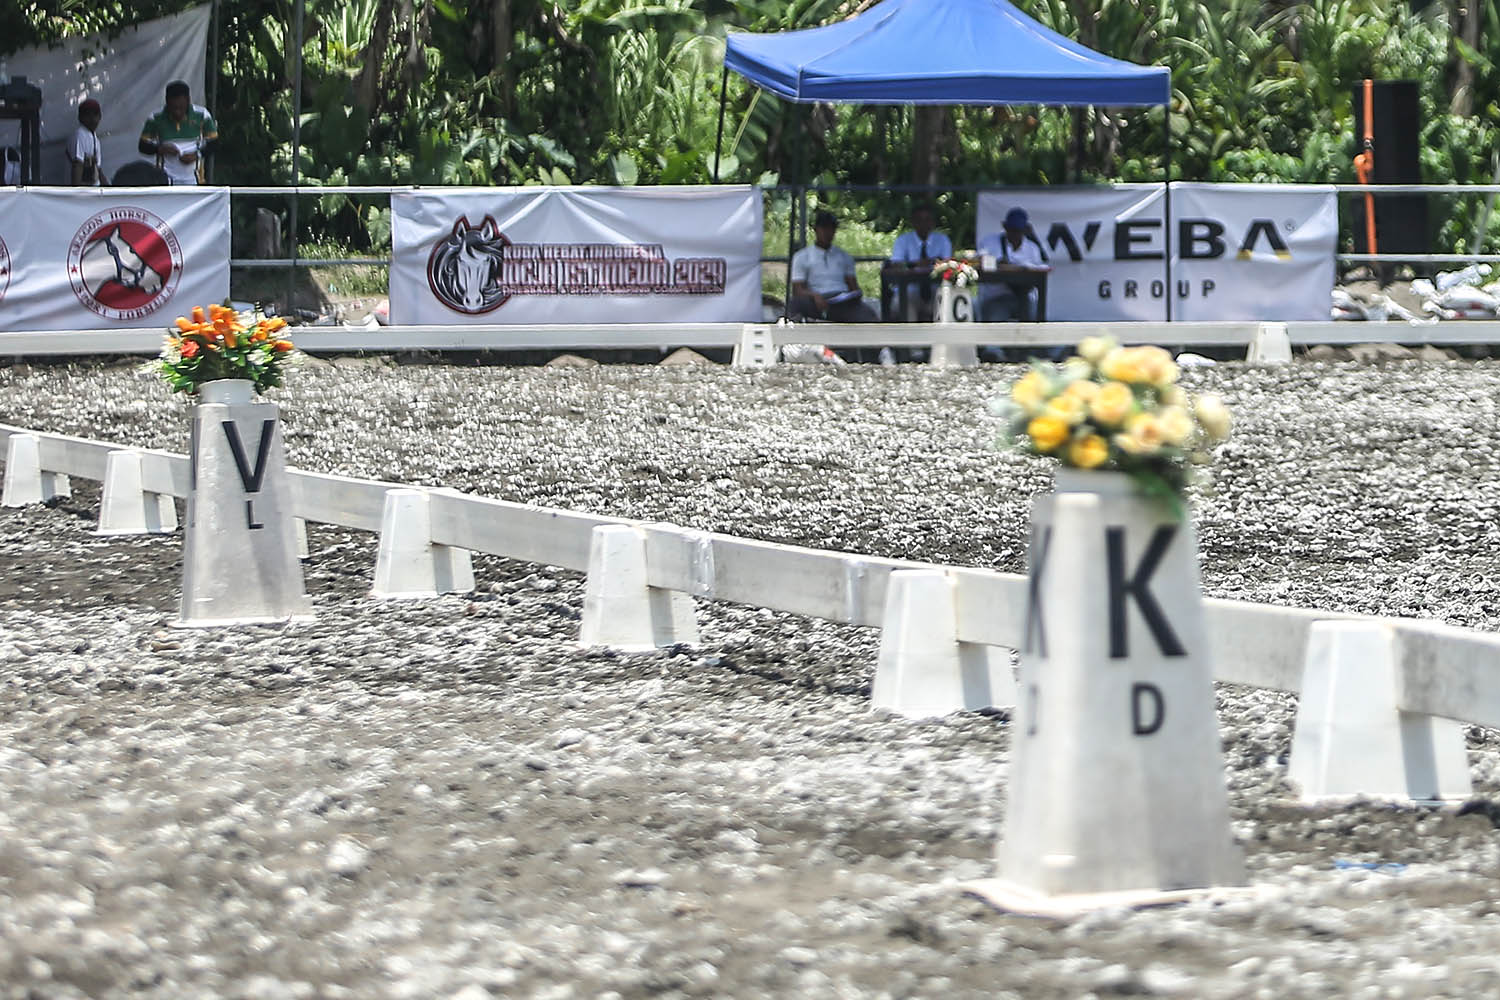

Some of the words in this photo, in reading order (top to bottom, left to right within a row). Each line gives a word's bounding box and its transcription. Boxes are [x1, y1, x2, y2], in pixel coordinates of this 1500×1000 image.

[110, 209, 147, 222] HORSE
[1023, 218, 1293, 262] WEBA
[674, 260, 725, 285] 2024
[1098, 279, 1216, 299] GROUP
[953, 295, 968, 322] C
[221, 420, 277, 493] V
[246, 500, 265, 530] L
[1105, 524, 1189, 658] K
[1131, 682, 1166, 737] D
